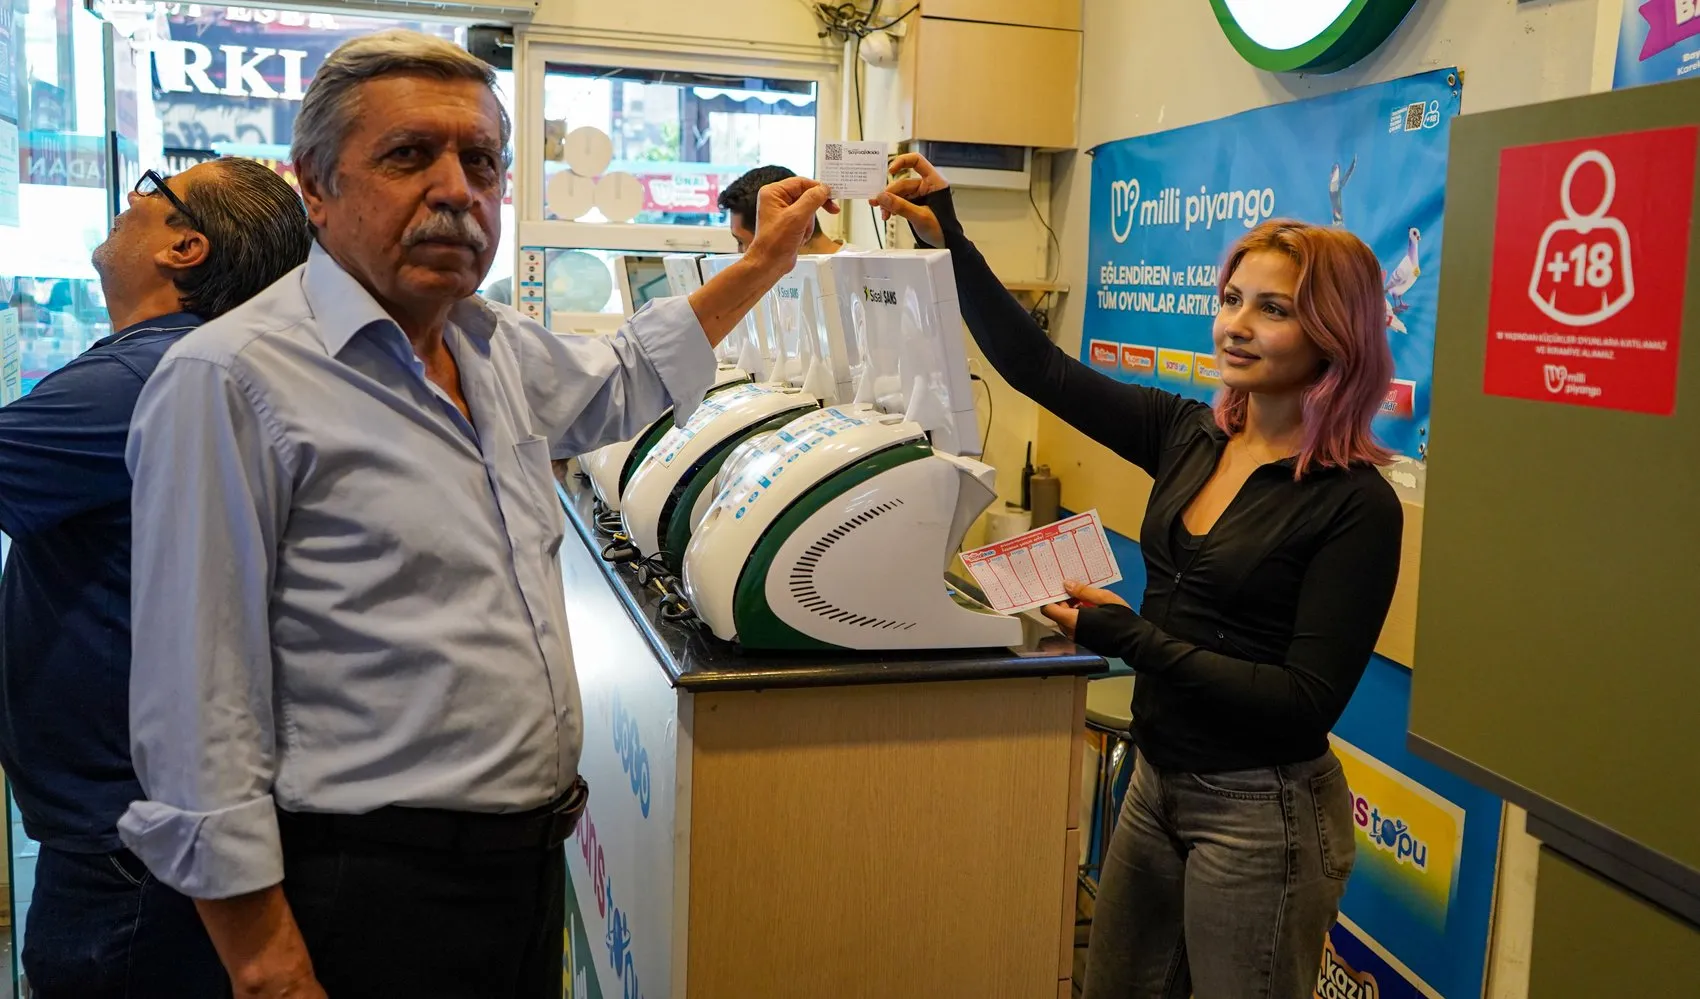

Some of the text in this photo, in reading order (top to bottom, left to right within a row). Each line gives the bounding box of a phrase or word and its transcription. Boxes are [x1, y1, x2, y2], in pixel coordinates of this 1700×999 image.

[1140, 187, 1181, 226] milli
[1185, 185, 1275, 231] piyango
[1100, 260, 1170, 286] EĞLENDİREN
[1547, 242, 1614, 288] +18
[1097, 285, 1117, 310] TÜM
[1118, 291, 1175, 314] OYUNLAR
[1177, 293, 1211, 316] ARTIK
